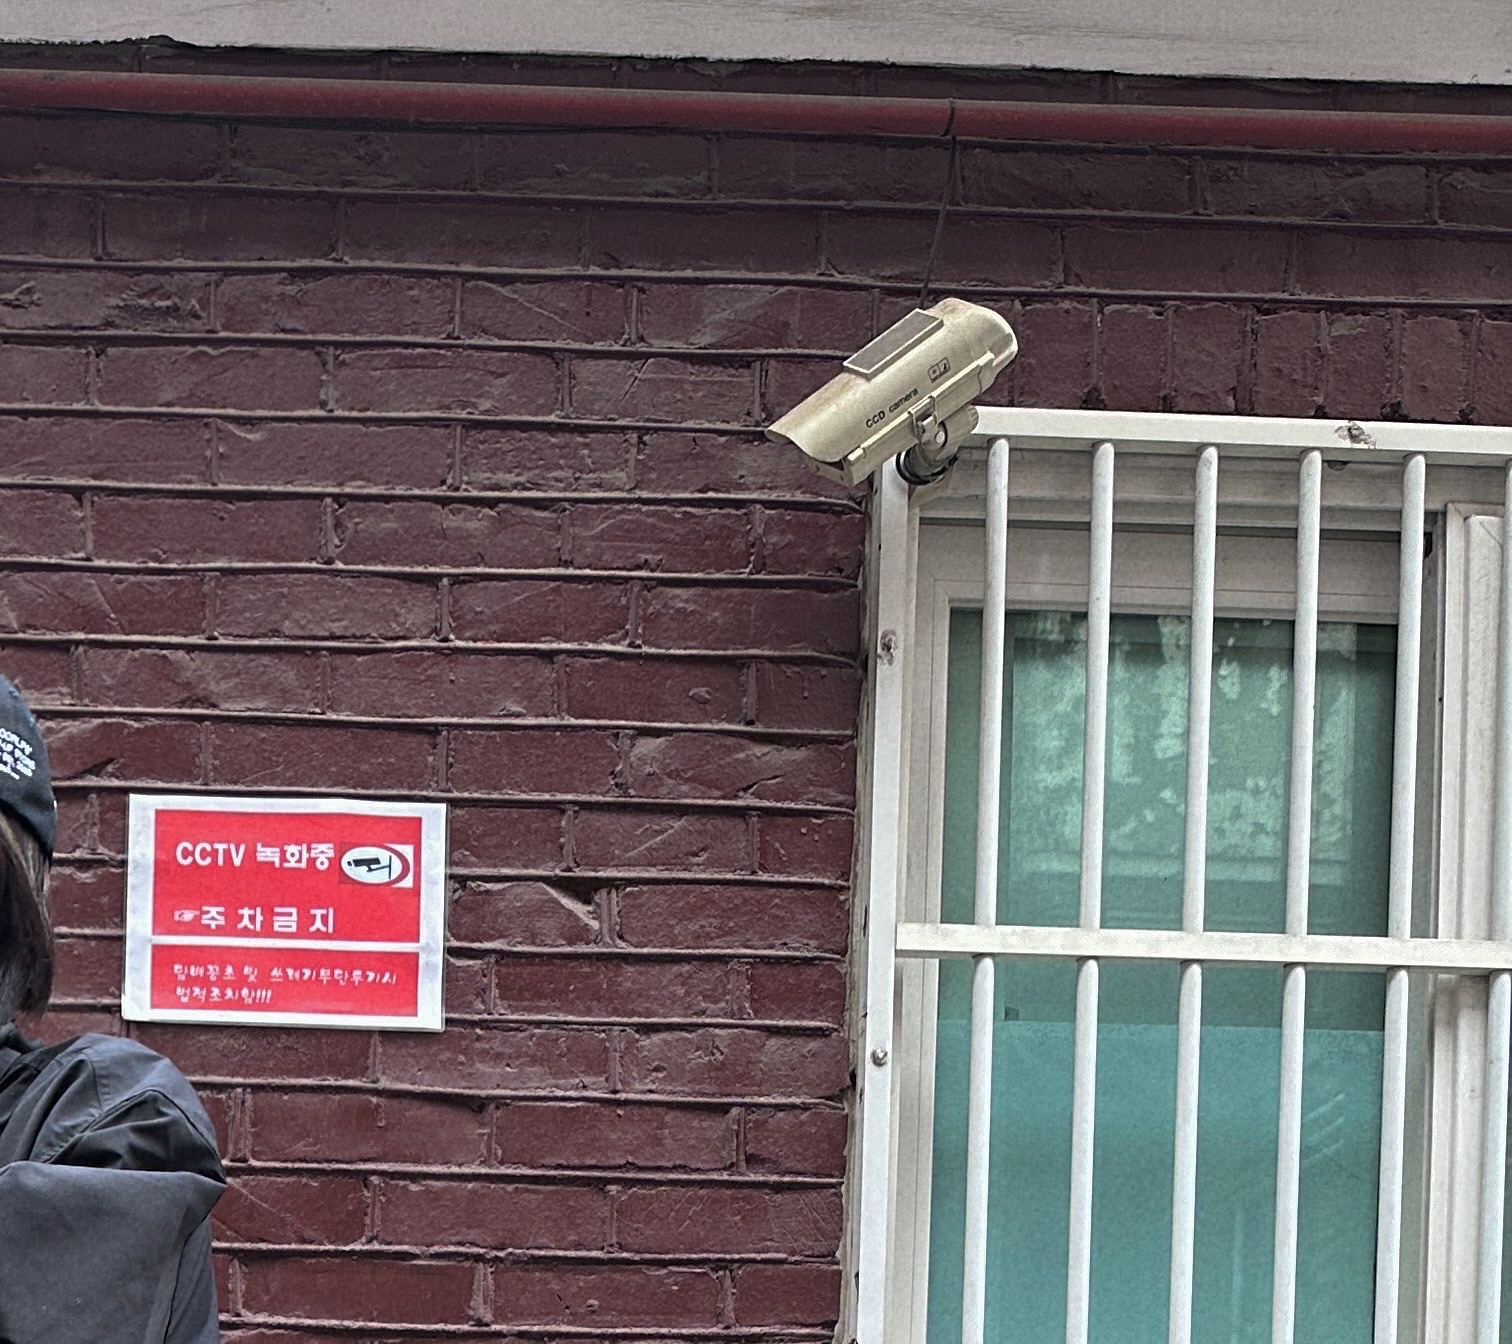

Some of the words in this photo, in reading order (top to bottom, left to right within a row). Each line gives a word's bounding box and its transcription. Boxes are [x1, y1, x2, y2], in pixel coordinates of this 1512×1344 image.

[866, 410, 886, 428] CCD
[888, 387, 919, 413] camera
[175, 841, 246, 867] CCTV
[255, 842, 335, 871] 녹화중
[243, 965, 259, 984] 및
